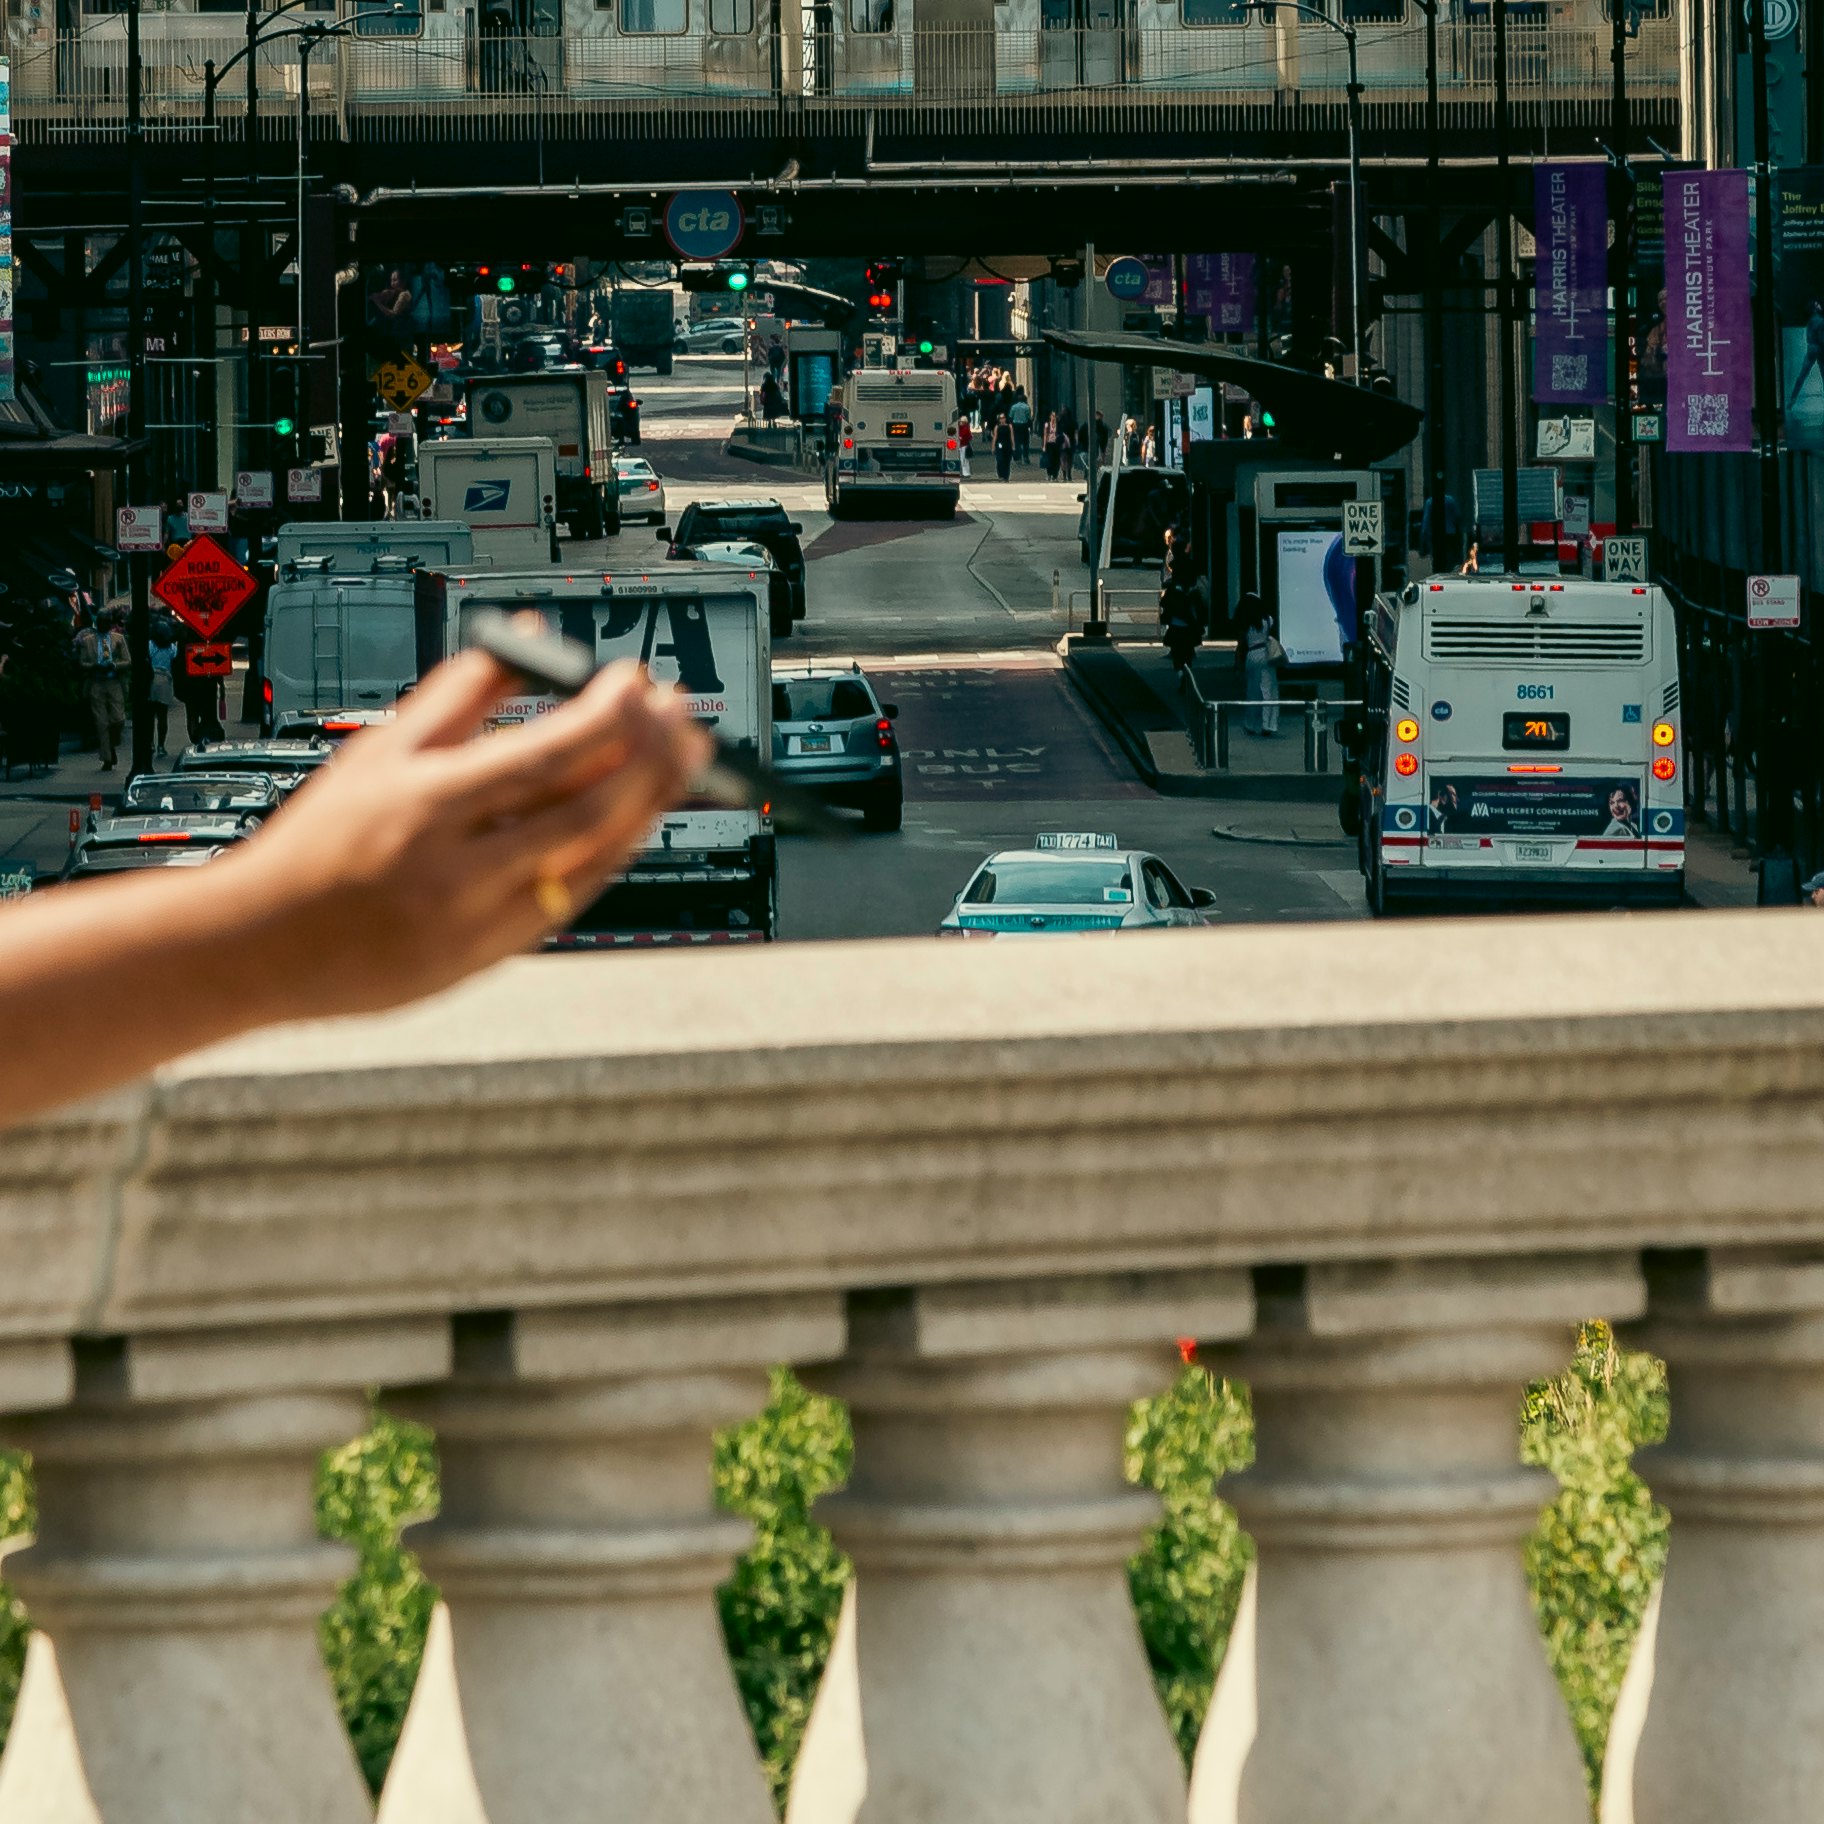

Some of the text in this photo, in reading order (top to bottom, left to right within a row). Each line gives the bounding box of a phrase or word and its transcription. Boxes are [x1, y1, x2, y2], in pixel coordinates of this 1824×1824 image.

[1781, 192, 1802, 201] The
[1781, 204, 1818, 216] Joffrey
[678, 208, 730, 232] cta
[1706, 220, 1714, 250] PARK
[1551, 172, 1567, 316] HARRIS THEATER
[1684, 182, 1704, 349] HARRIS THEATER
[1114, 272, 1142, 285] cta
[1348, 505, 1378, 518] ONE
[1349, 520, 1379, 533] WAY
[1608, 542, 1642, 555] ONE
[187, 562, 221, 574] ROAD
[1608, 558, 1643, 572] WAY
[162, 578, 246, 594] CONSTRUCTION
[1517, 684, 1554, 699] 8661
[494, 701, 532, 716] Beer
[684, 699, 728, 713] mble.
[900, 747, 1046, 759] ONLY
[1470, 803, 1599, 817] AVA THE SECRET CONVERSATIONS
[1039, 833, 1113, 849] TAXI 1774 TAXI
[967, 916, 1026, 927] FLASH CAB
